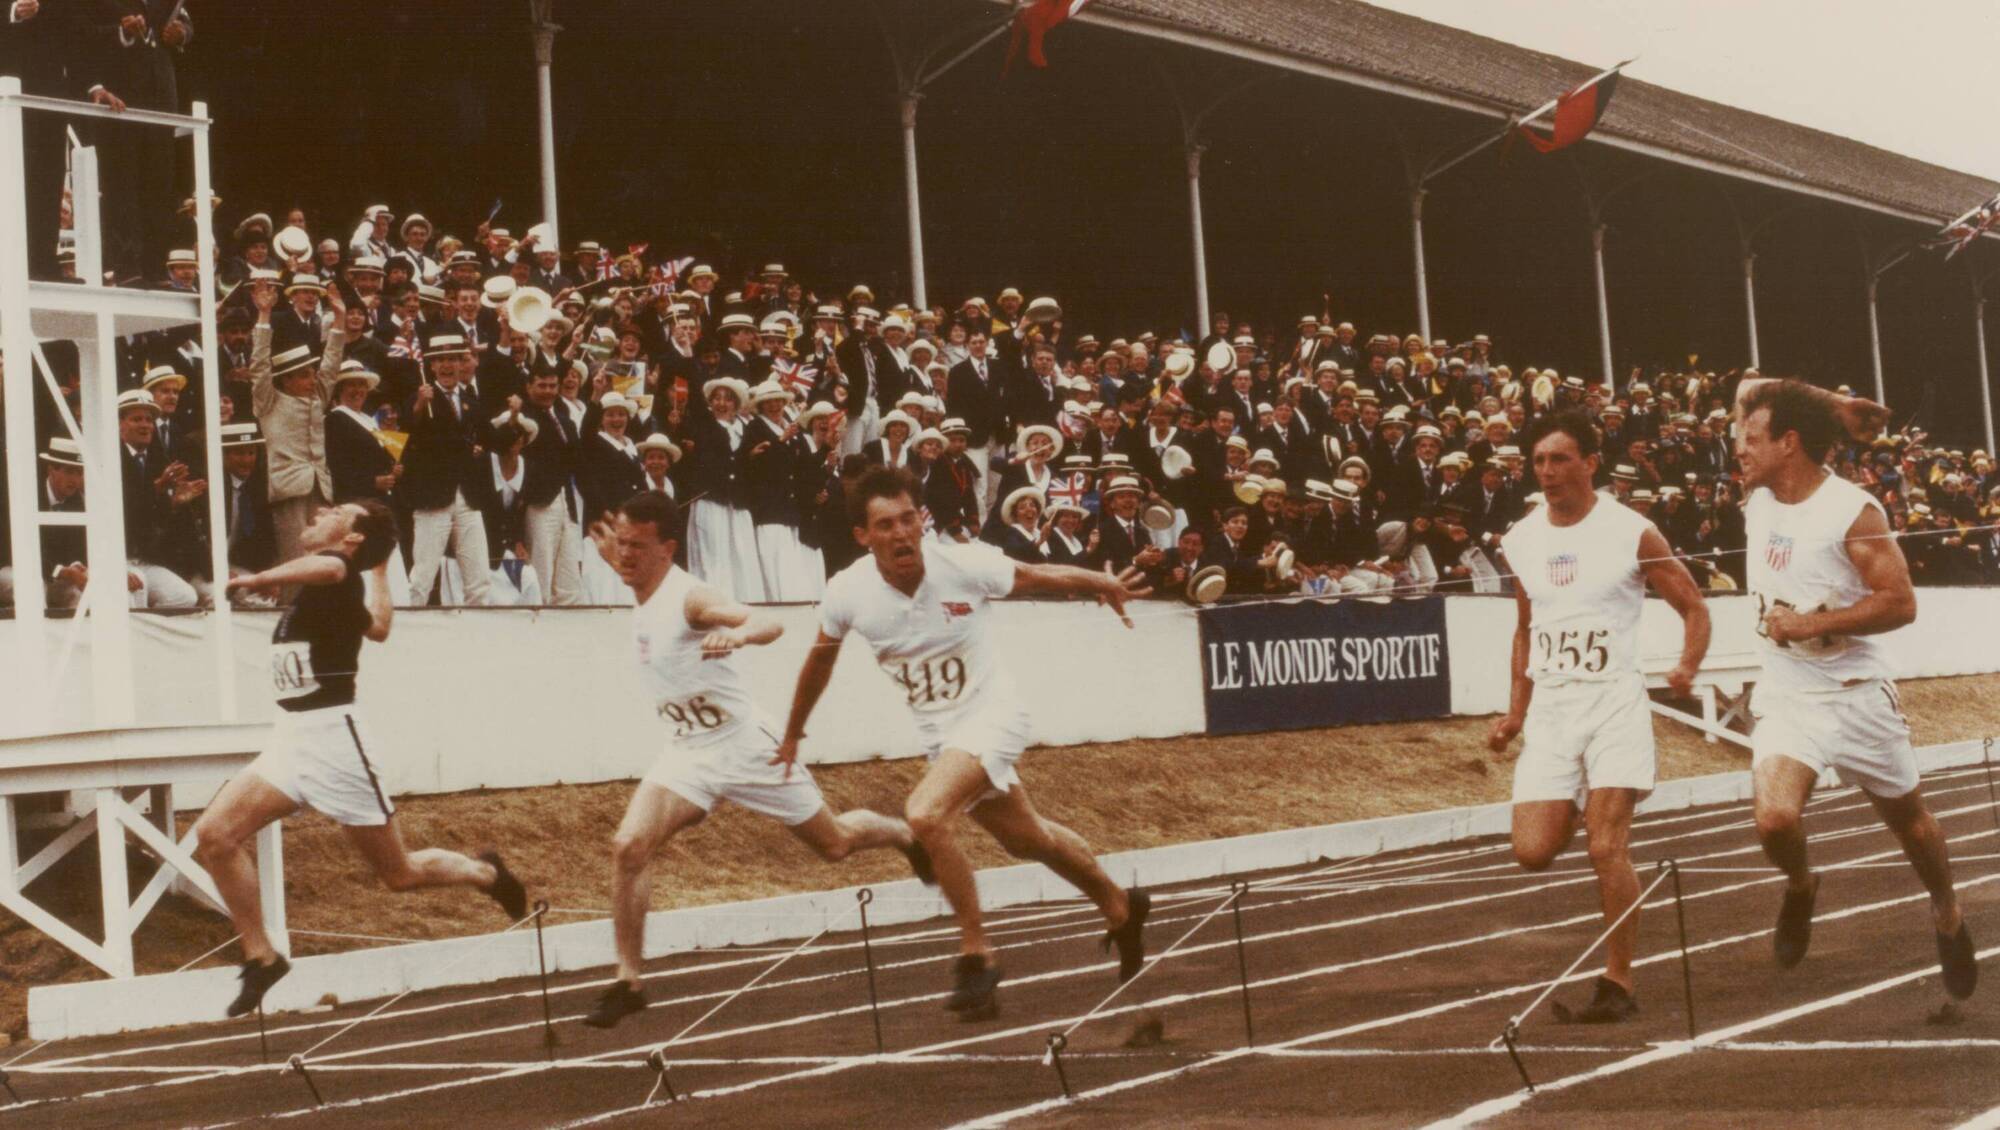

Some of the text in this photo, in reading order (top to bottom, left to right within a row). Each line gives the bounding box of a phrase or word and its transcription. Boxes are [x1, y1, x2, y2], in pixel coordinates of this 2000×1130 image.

[1209, 633, 1441, 690] LE MONDE SPORTIF
